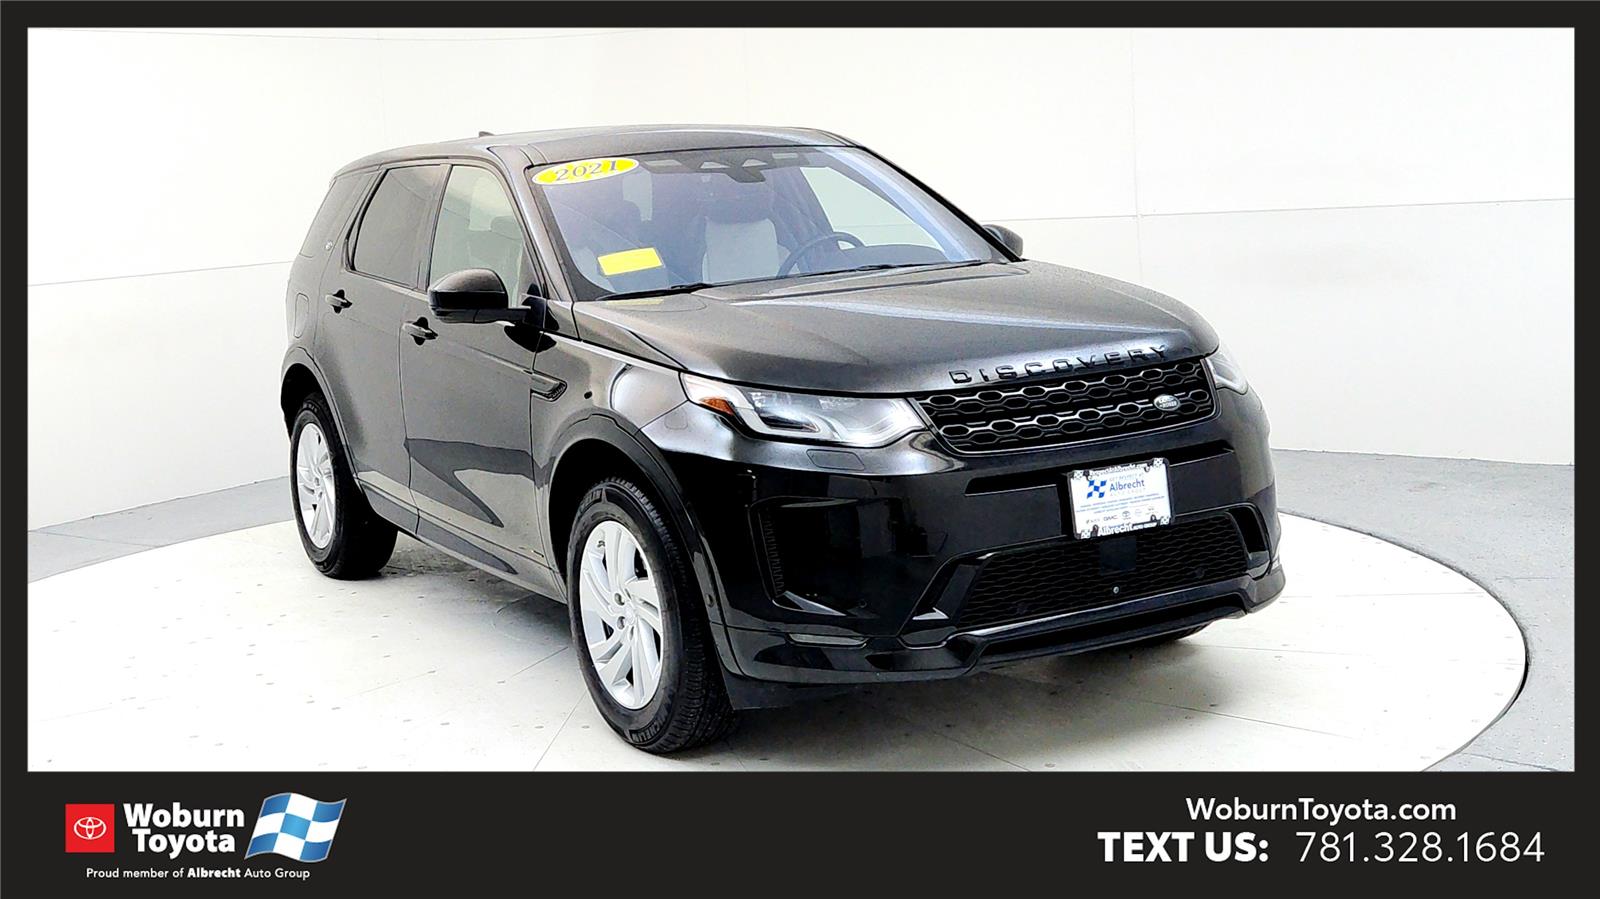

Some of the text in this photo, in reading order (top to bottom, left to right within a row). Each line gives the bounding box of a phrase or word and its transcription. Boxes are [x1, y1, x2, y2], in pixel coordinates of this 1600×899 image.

[555, 160, 618, 181] 2021
[948, 344, 1167, 384] DISCOVERY
[1109, 479, 1145, 492] Albrecht
[1097, 522, 1133, 536] Albrecht
